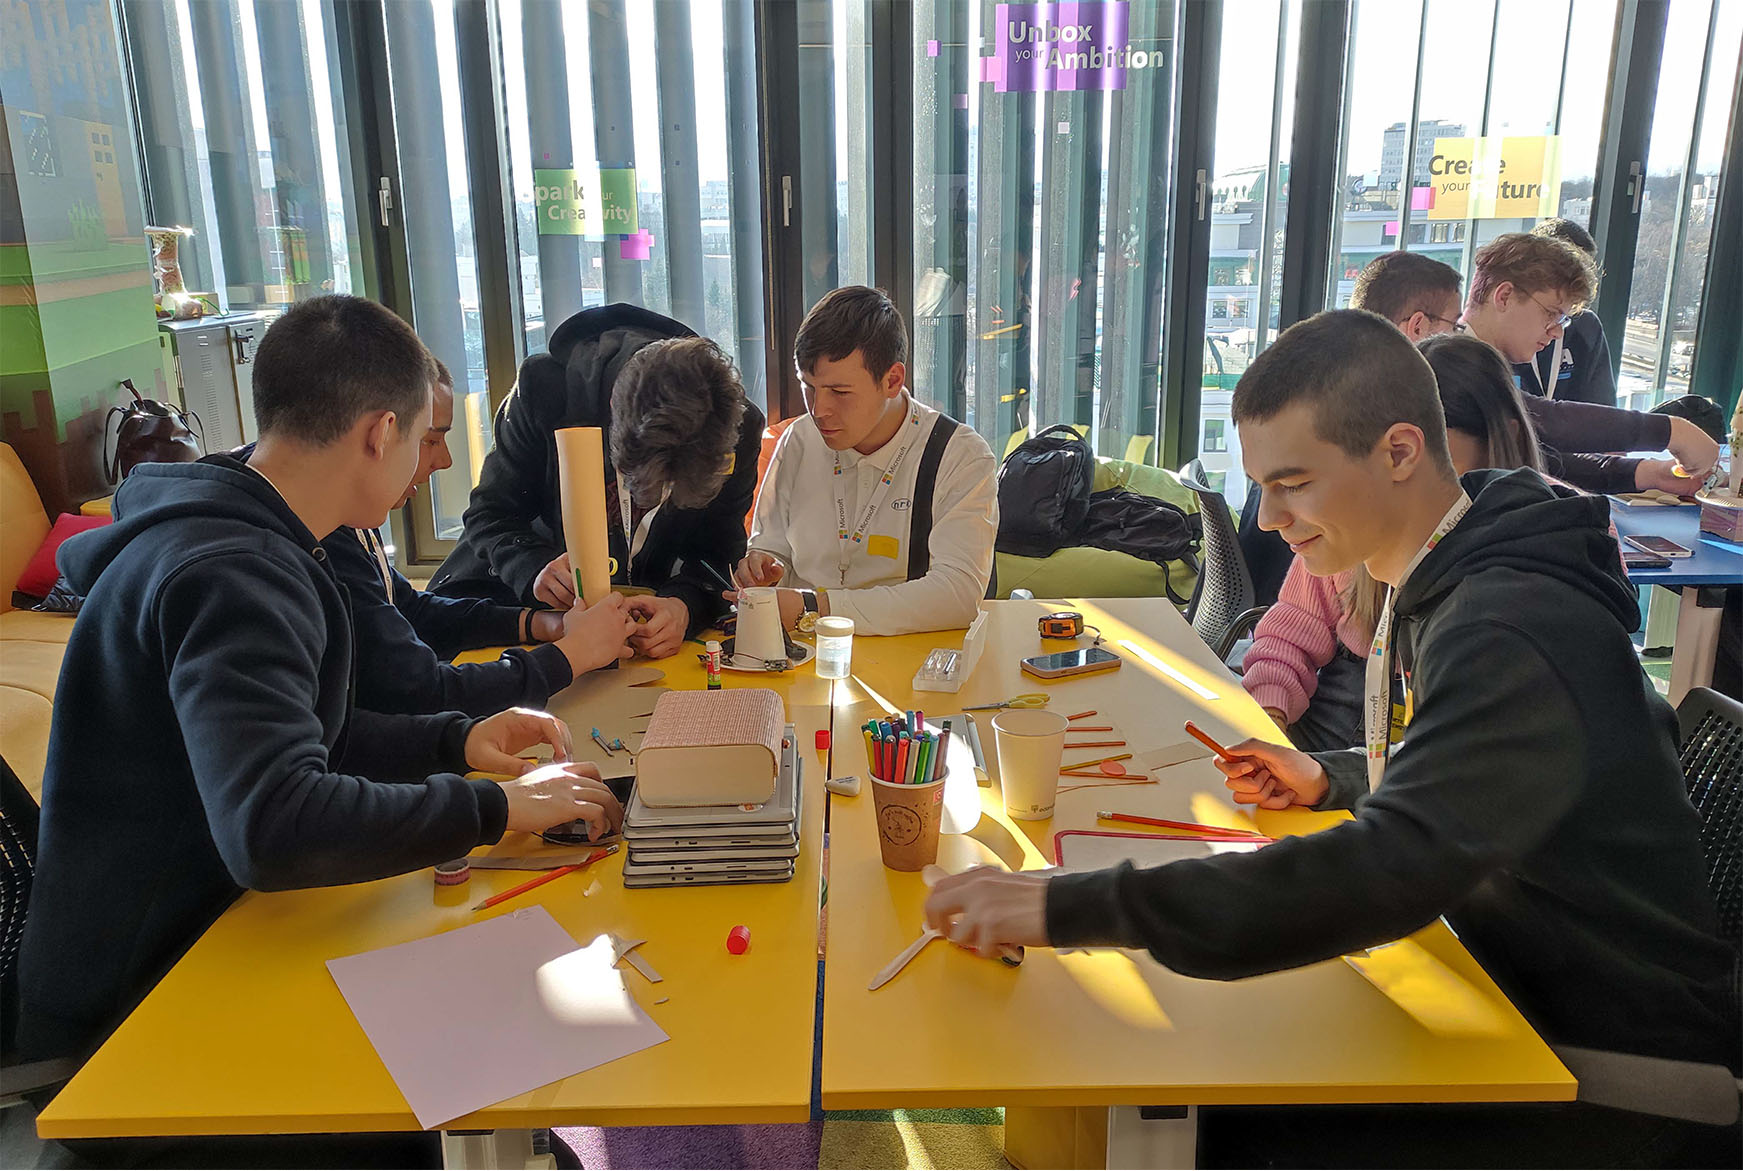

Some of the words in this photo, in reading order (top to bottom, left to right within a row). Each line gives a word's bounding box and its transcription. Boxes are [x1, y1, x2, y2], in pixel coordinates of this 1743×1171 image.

[1009, 20, 1092, 43] Unbox
[1015, 50, 1044, 63] your
[1046, 45, 1164, 70] Ambition
[1428, 155, 1506, 176] Creae
[534, 180, 585, 207] park
[1441, 182, 1471, 195] your
[548, 204, 633, 224] Creavity
[888, 446, 907, 475] Microsoft
[837, 498, 846, 529] Microsoft
[858, 504, 877, 533] Microsoft
[1379, 690, 1388, 740] Microsoft
